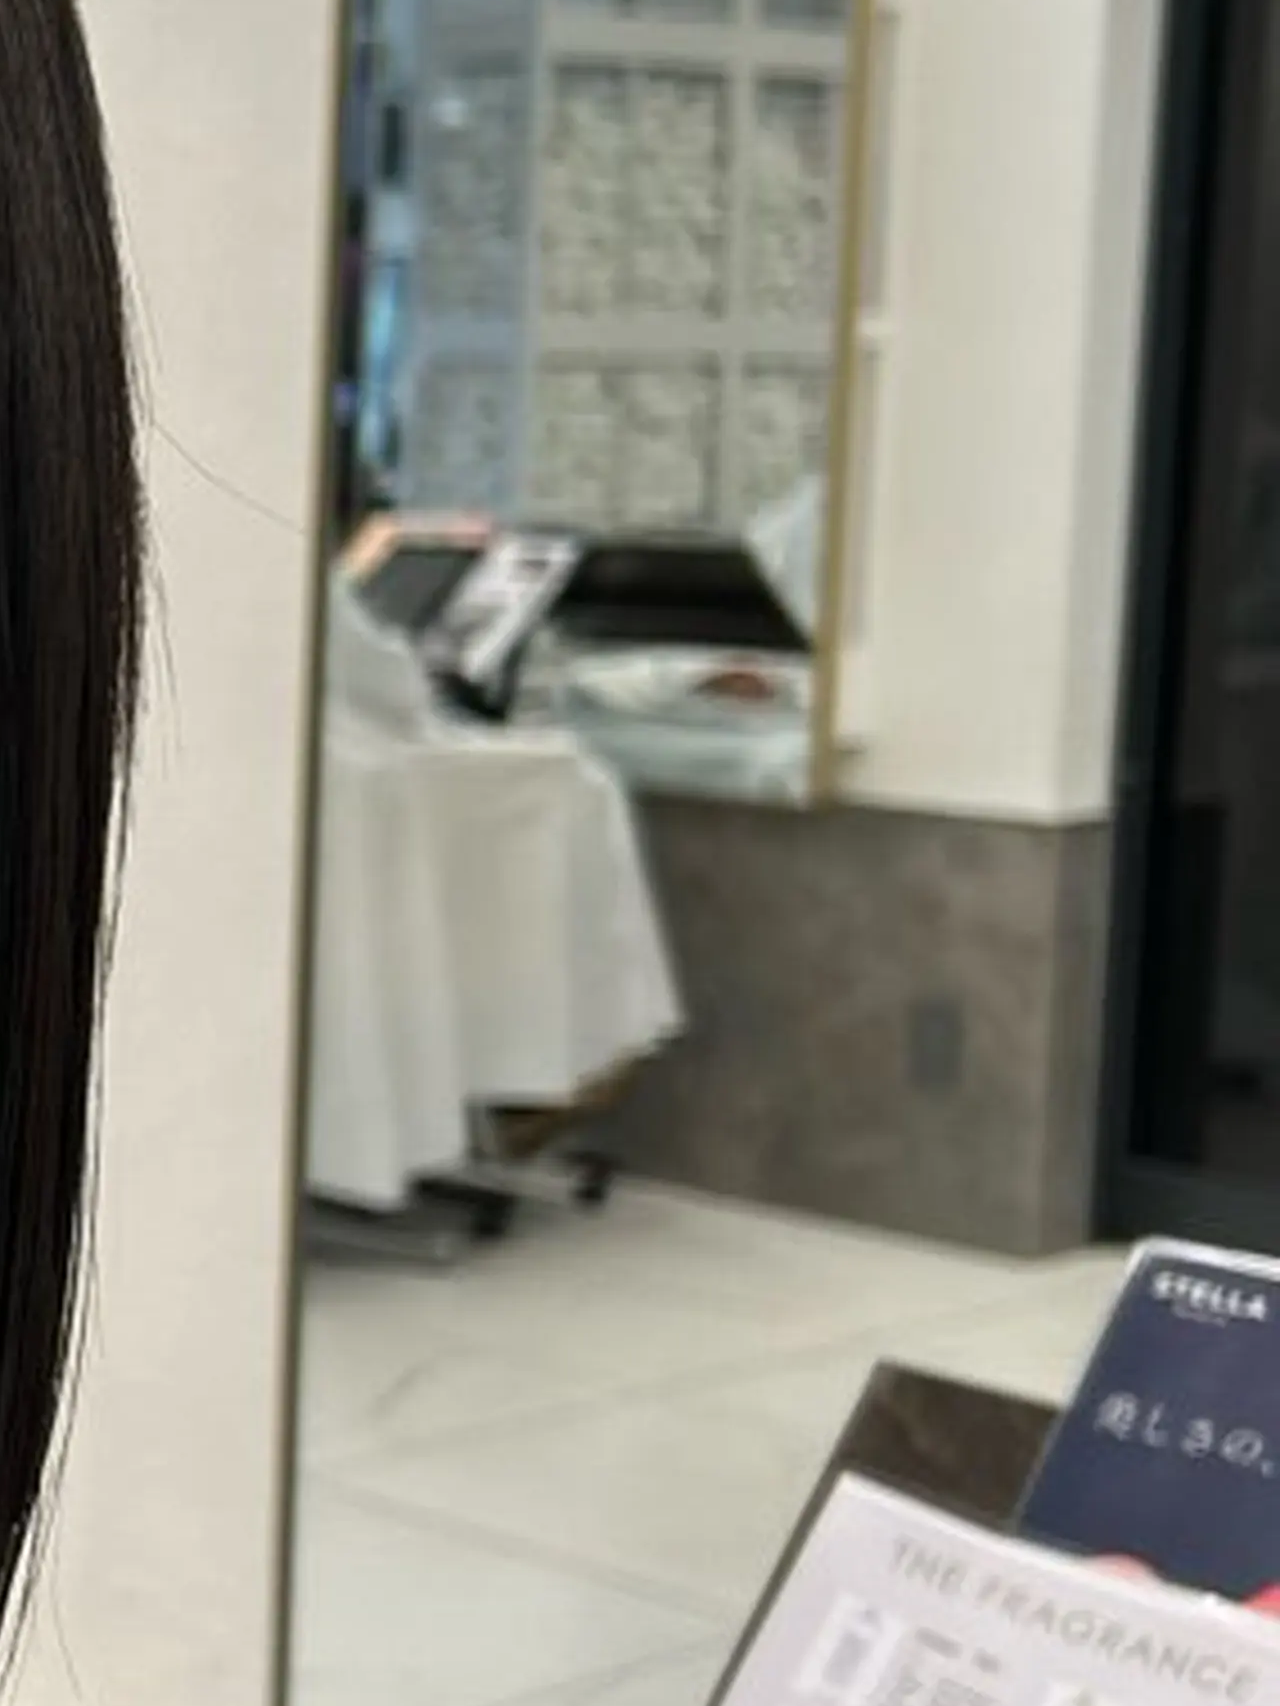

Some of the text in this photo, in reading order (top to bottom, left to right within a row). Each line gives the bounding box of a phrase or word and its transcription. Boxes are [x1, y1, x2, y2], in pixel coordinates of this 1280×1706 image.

[1152, 1270, 1268, 1323] STELLA
[889, 1536, 970, 1597] THE
[975, 1573, 1262, 1706] FRAGRANCE
